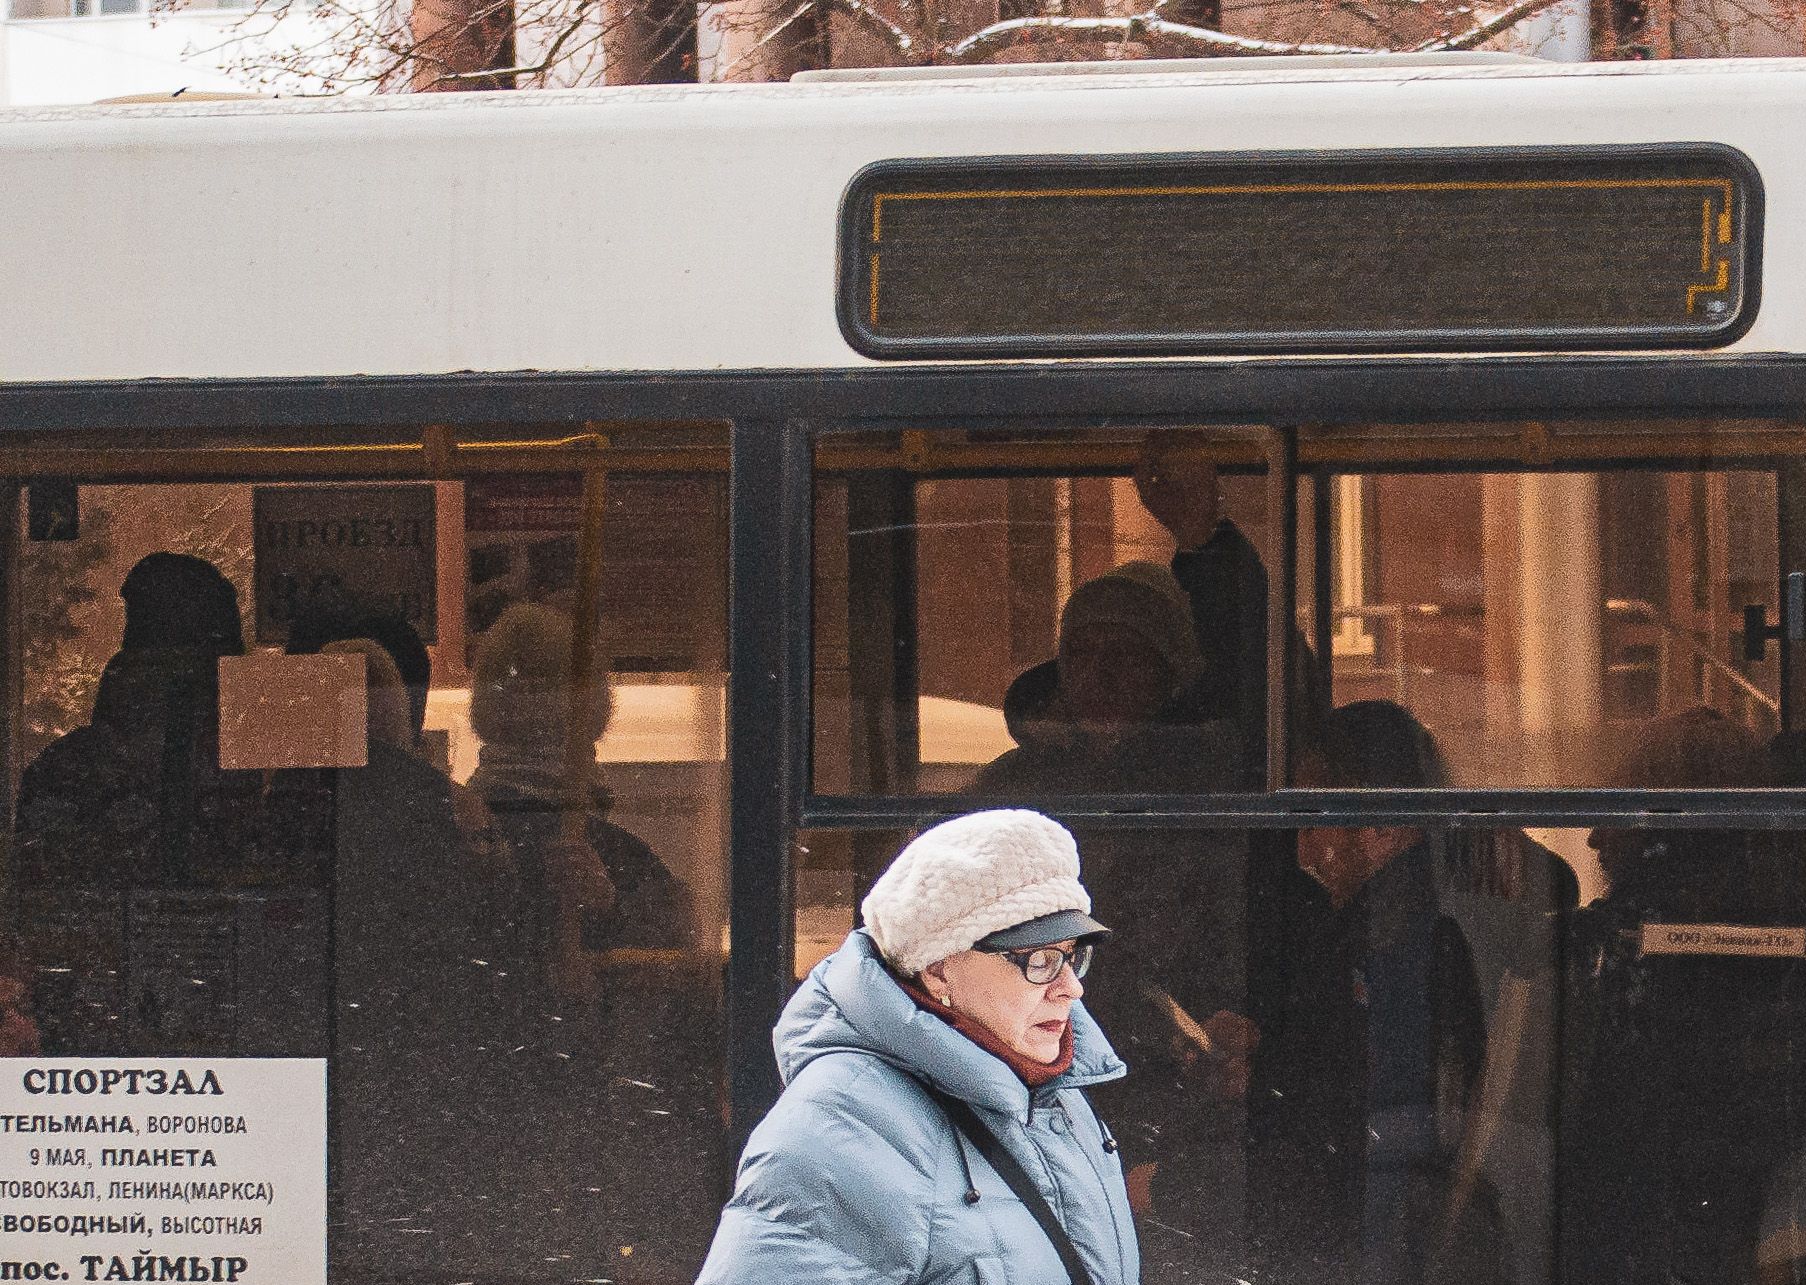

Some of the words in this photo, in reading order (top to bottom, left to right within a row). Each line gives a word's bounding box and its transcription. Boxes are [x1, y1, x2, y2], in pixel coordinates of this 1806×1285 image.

[23, 1068, 224, 1096] СПОРТЗАЛ
[0, 1115, 140, 1137] ТЕЛЬМАНА,
[147, 1115, 248, 1135] ВОРОНОВА
[30, 1148, 40, 1166] 9
[46, 1149, 94, 1170] МАЯ,
[101, 1149, 217, 1168] ПЛАНЕТА
[108, 1180, 274, 1206] ЛЕНИНА(МАРКСА)
[0, 1212, 153, 1238] ВОБОДНЫЙ,
[161, 1216, 262, 1236] ВЫСОТНАЯ
[1, 1260, 70, 1282] пос.
[80, 1249, 249, 1283] ТАЙМЫР
